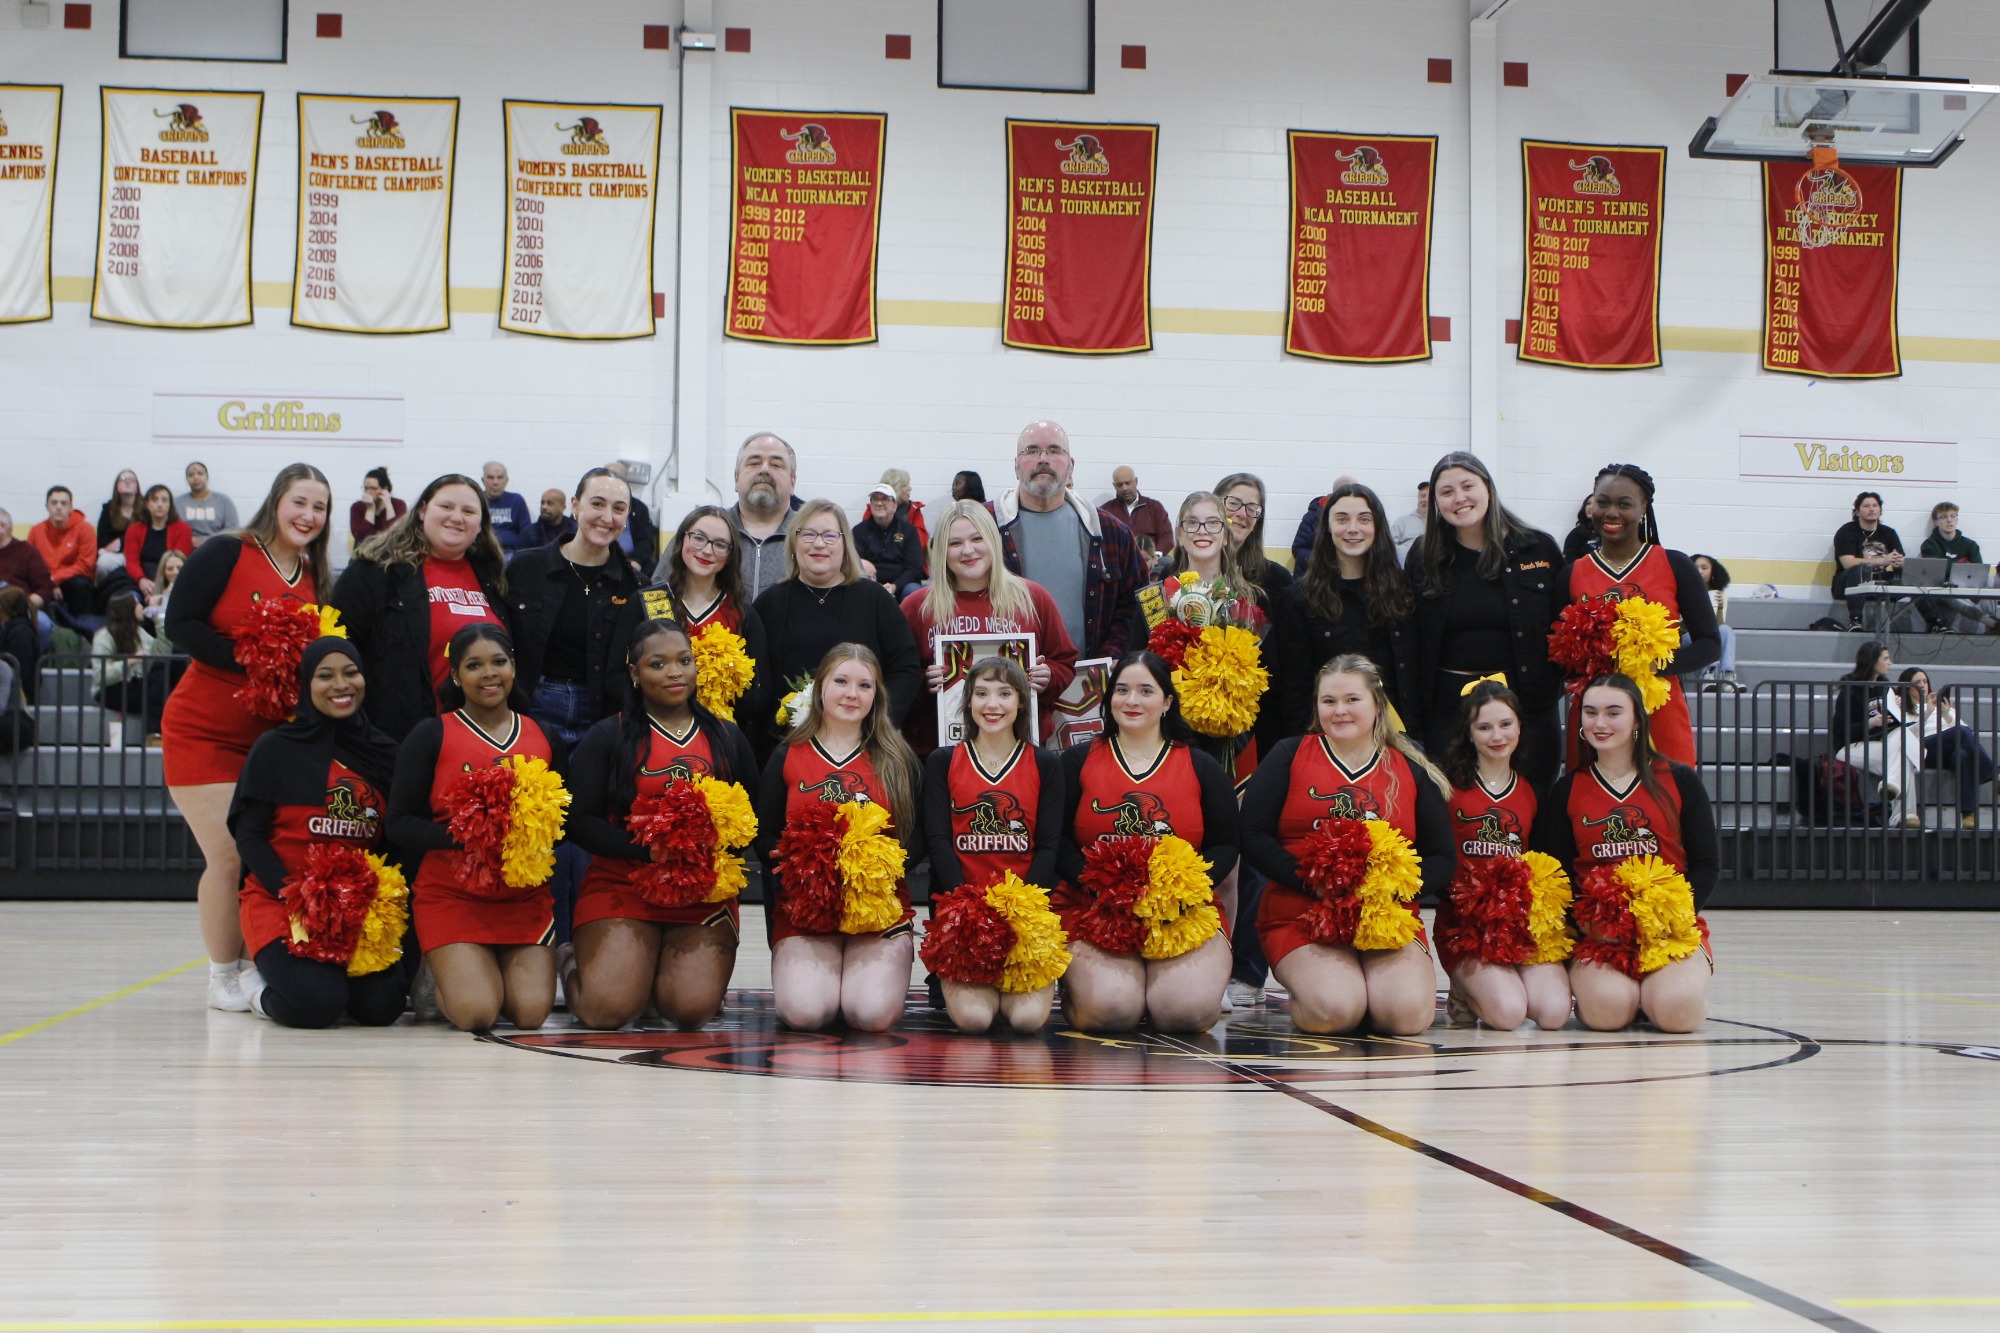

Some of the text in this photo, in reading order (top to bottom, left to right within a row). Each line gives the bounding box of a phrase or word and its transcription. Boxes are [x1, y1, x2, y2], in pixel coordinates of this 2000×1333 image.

[0, 144, 42, 160] ENNIS
[140, 148, 218, 166] BASEBALL
[787, 150, 836, 163] GRIFFINS
[310, 153, 444, 171] MEN'S BASKETBALL
[518, 159, 647, 179] WOMEN'S BASKETBALL
[1062, 162, 1108, 174] GRIFFINS
[0, 165, 46, 180] AMPIONS
[114, 166, 248, 186] CONFERENCE CHAMPIONS
[744, 166, 872, 186] WOMEN'S BASKETBALL
[1342, 172, 1388, 184] GRIFFINS
[309, 174, 444, 192] CONFERENCE CHAMPIONS
[516, 178, 648, 198] CONFERENCE CHAMPIONS
[1019, 177, 1146, 196] MEN'S BASKETBALL
[1574, 181, 1620, 194] GRIFFINS
[112, 187, 141, 201] 2000
[309, 193, 338, 208] 1999
[746, 186, 868, 206] NCAA TOURNAMENT
[1326, 189, 1396, 206] BASEBALL
[110, 206, 140, 220] 2001
[516, 198, 544, 214] 2000
[1022, 197, 1142, 215] NCAA TOURNAMENT
[1538, 197, 1648, 216] WOMEN'S TENNIS
[309, 212, 338, 226] 2004
[741, 205, 806, 224] 1999 2012
[1304, 206, 1418, 226] NCAA TOURNAMENT
[110, 224, 140, 239] 2007
[517, 217, 544, 232] 2001
[1016, 216, 1046, 232] 2004
[1538, 216, 1649, 236] NCAA TOURNAMENT
[308, 230, 337, 244] 2005
[741, 224, 804, 242] 2000 2017
[1300, 224, 1326, 242] 2000
[108, 242, 139, 258] 2008
[516, 236, 544, 250] 2003
[740, 241, 768, 258] 2001
[1018, 234, 1046, 250] 2005
[1533, 233, 1590, 252] 2008 2017
[308, 249, 336, 264] 2009
[1016, 250, 1046, 268] 2009
[1299, 243, 1326, 259] 2001
[1773, 246, 1800, 260] 1999
[108, 261, 138, 276] 2019
[515, 254, 543, 268] 2006
[738, 259, 768, 276] 2003
[1298, 261, 1326, 276] 2006
[1532, 252, 1589, 269] 2009 2018
[307, 266, 335, 282] 2016
[1016, 268, 1044, 286] 2011
[1532, 269, 1560, 284] 2010
[1775, 263, 1800, 278] 2011
[514, 272, 542, 288] 2007
[738, 276, 767, 294] 2004
[1296, 279, 1326, 294] 2007
[1774, 279, 1800, 296] 2012
[305, 284, 336, 300] 2019
[513, 290, 542, 306] 2012
[1014, 287, 1044, 302] 2016
[1534, 286, 1559, 302] 2011
[737, 295, 766, 312] 2006
[1296, 296, 1326, 312] 2008
[1532, 303, 1558, 320] 2013
[1774, 297, 1798, 312] 2013
[512, 308, 541, 324] 2017
[1014, 305, 1044, 321] 2019
[735, 314, 765, 330] 2007
[1531, 320, 1558, 336] 2015
[1772, 314, 1798, 329] 2014
[1530, 337, 1556, 353] 2016
[1772, 331, 1799, 346] 2017
[1772, 348, 1798, 364] 2018
[218, 401, 342, 432] Griffins
[1794, 442, 1904, 474] Visitors
[984, 616, 1021, 634] MERCY
[308, 816, 376, 838] GRIFFINS
[956, 834, 1029, 852] GRIFFINS
[1463, 840, 1522, 858] GRIFFINS
[1592, 840, 1658, 858] GRIFFINS
